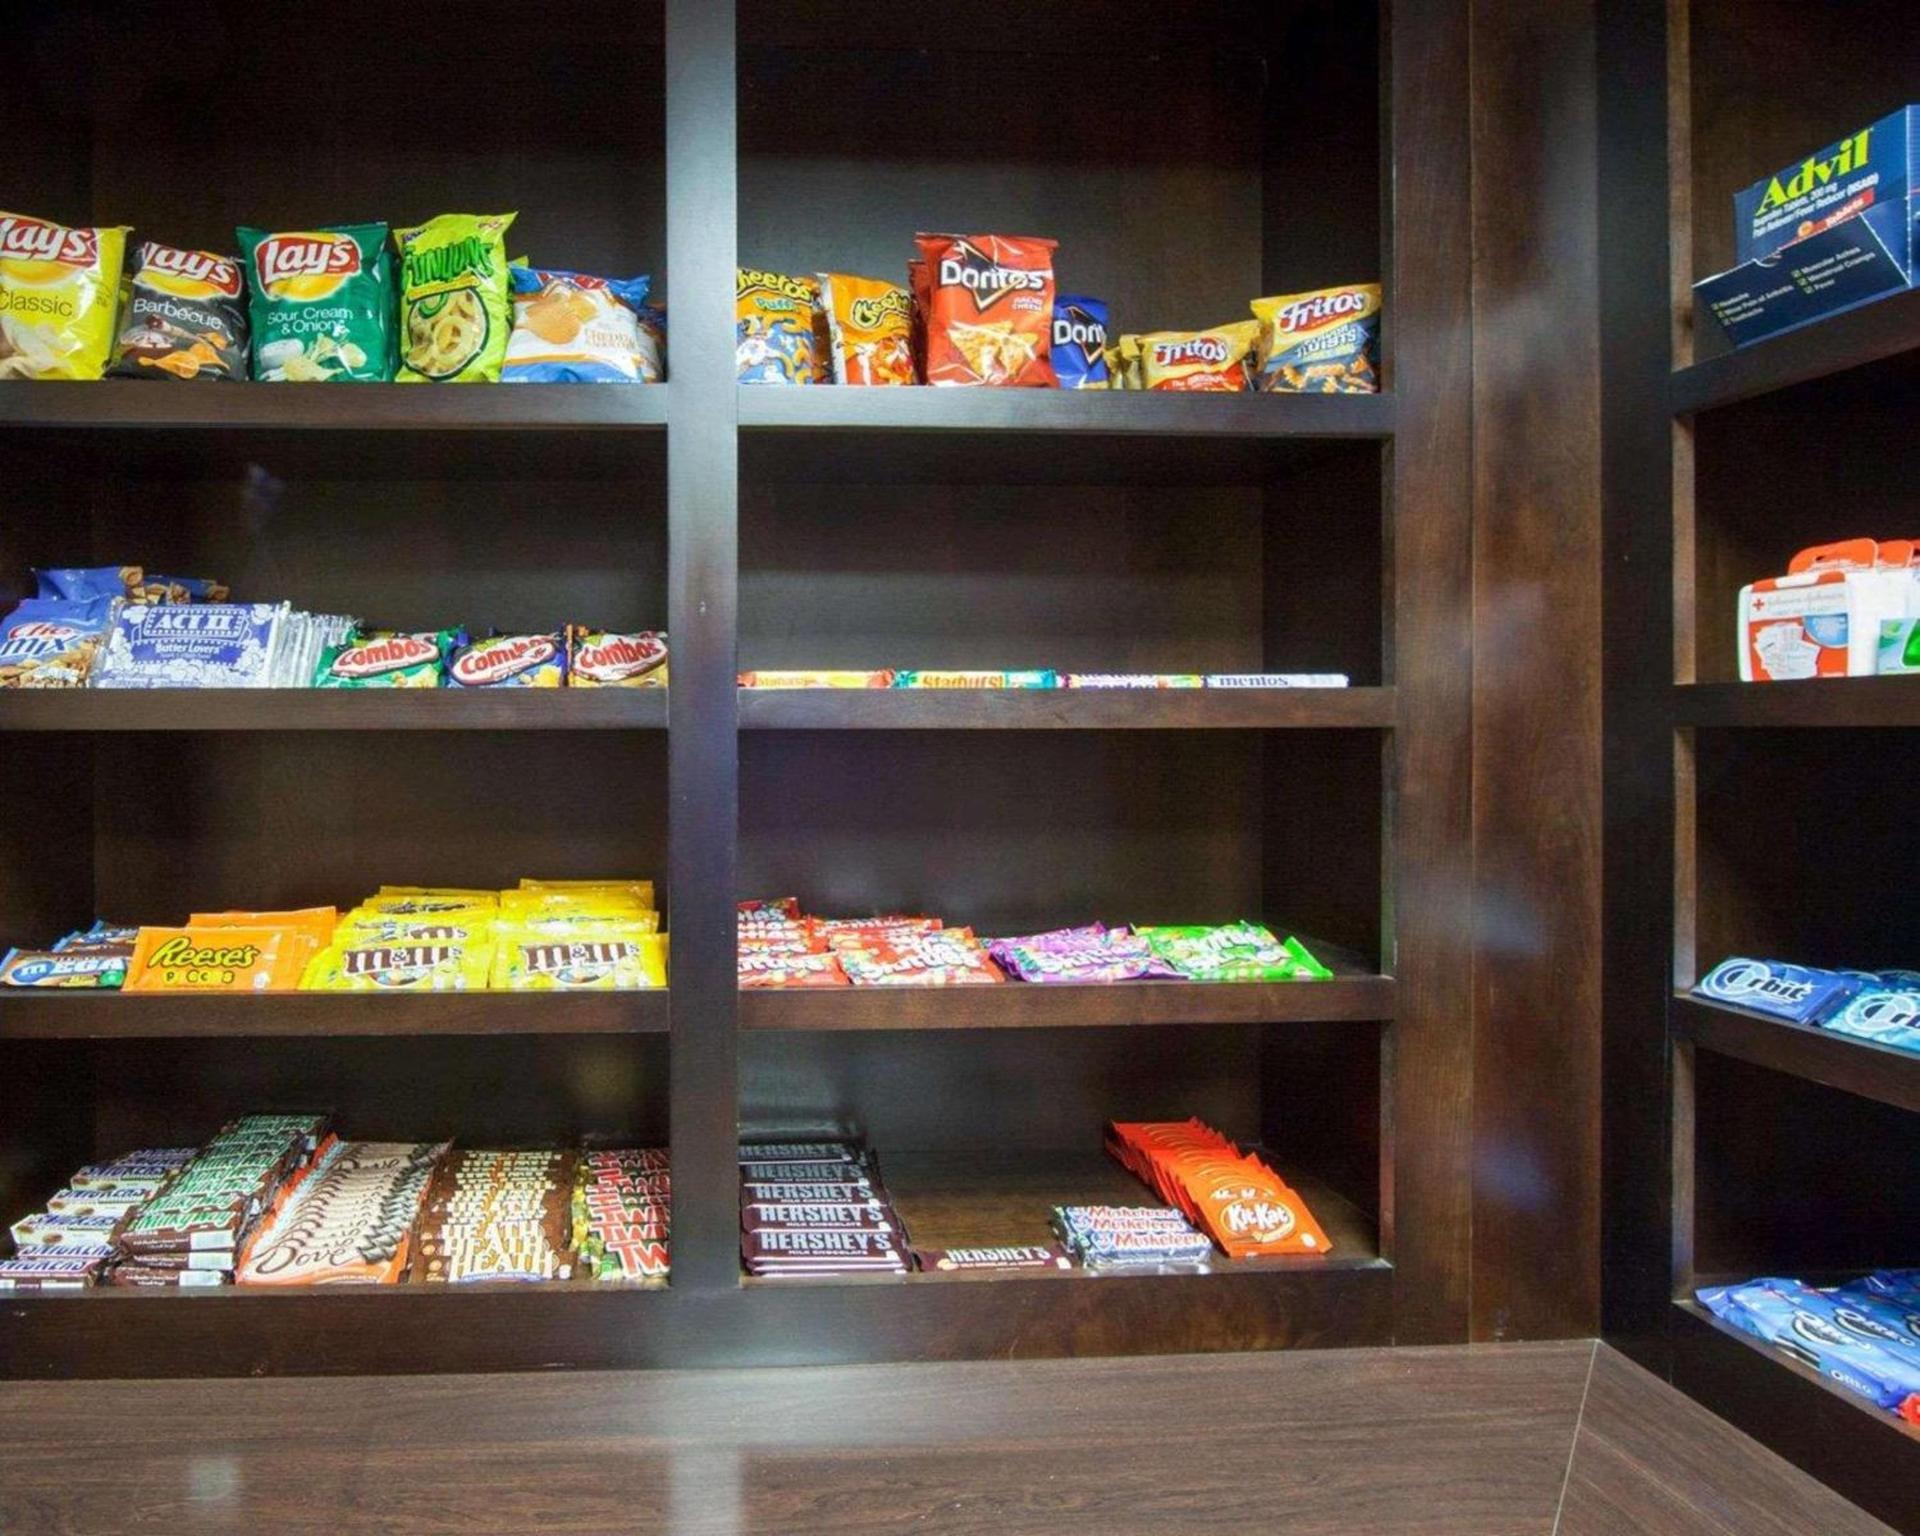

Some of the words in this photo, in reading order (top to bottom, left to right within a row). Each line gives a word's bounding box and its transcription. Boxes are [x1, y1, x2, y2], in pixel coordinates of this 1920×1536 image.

[1754, 127, 1870, 218] Advil
[737, 268, 812, 302] heetos
[941, 258, 1043, 292] Doritos
[133, 297, 223, 330] Barbecue
[267, 312, 299, 325] Sour
[303, 307, 353, 321] Cream
[1278, 292, 1366, 333] Fritos
[281, 323, 291, 336] &
[1154, 336, 1229, 366] Fritos
[155, 615, 202, 631] ACT
[206, 615, 234, 631] II
[337, 639, 433, 667] Combos
[580, 637, 663, 669] Combos
[1219, 674, 1289, 686] mentos
[147, 936, 261, 968] Reese's
[1713, 961, 1809, 1000] Orbit
[756, 1184, 874, 1199] HERSHEY'S
[759, 1203, 885, 1222] HERSHEY'S
[760, 1230, 893, 1251] HERSHEY'S
[945, 1246, 1052, 1262] HERSHEY'S
[250, 1245, 347, 1275] Dove
[448, 1250, 553, 1283] HEATH
